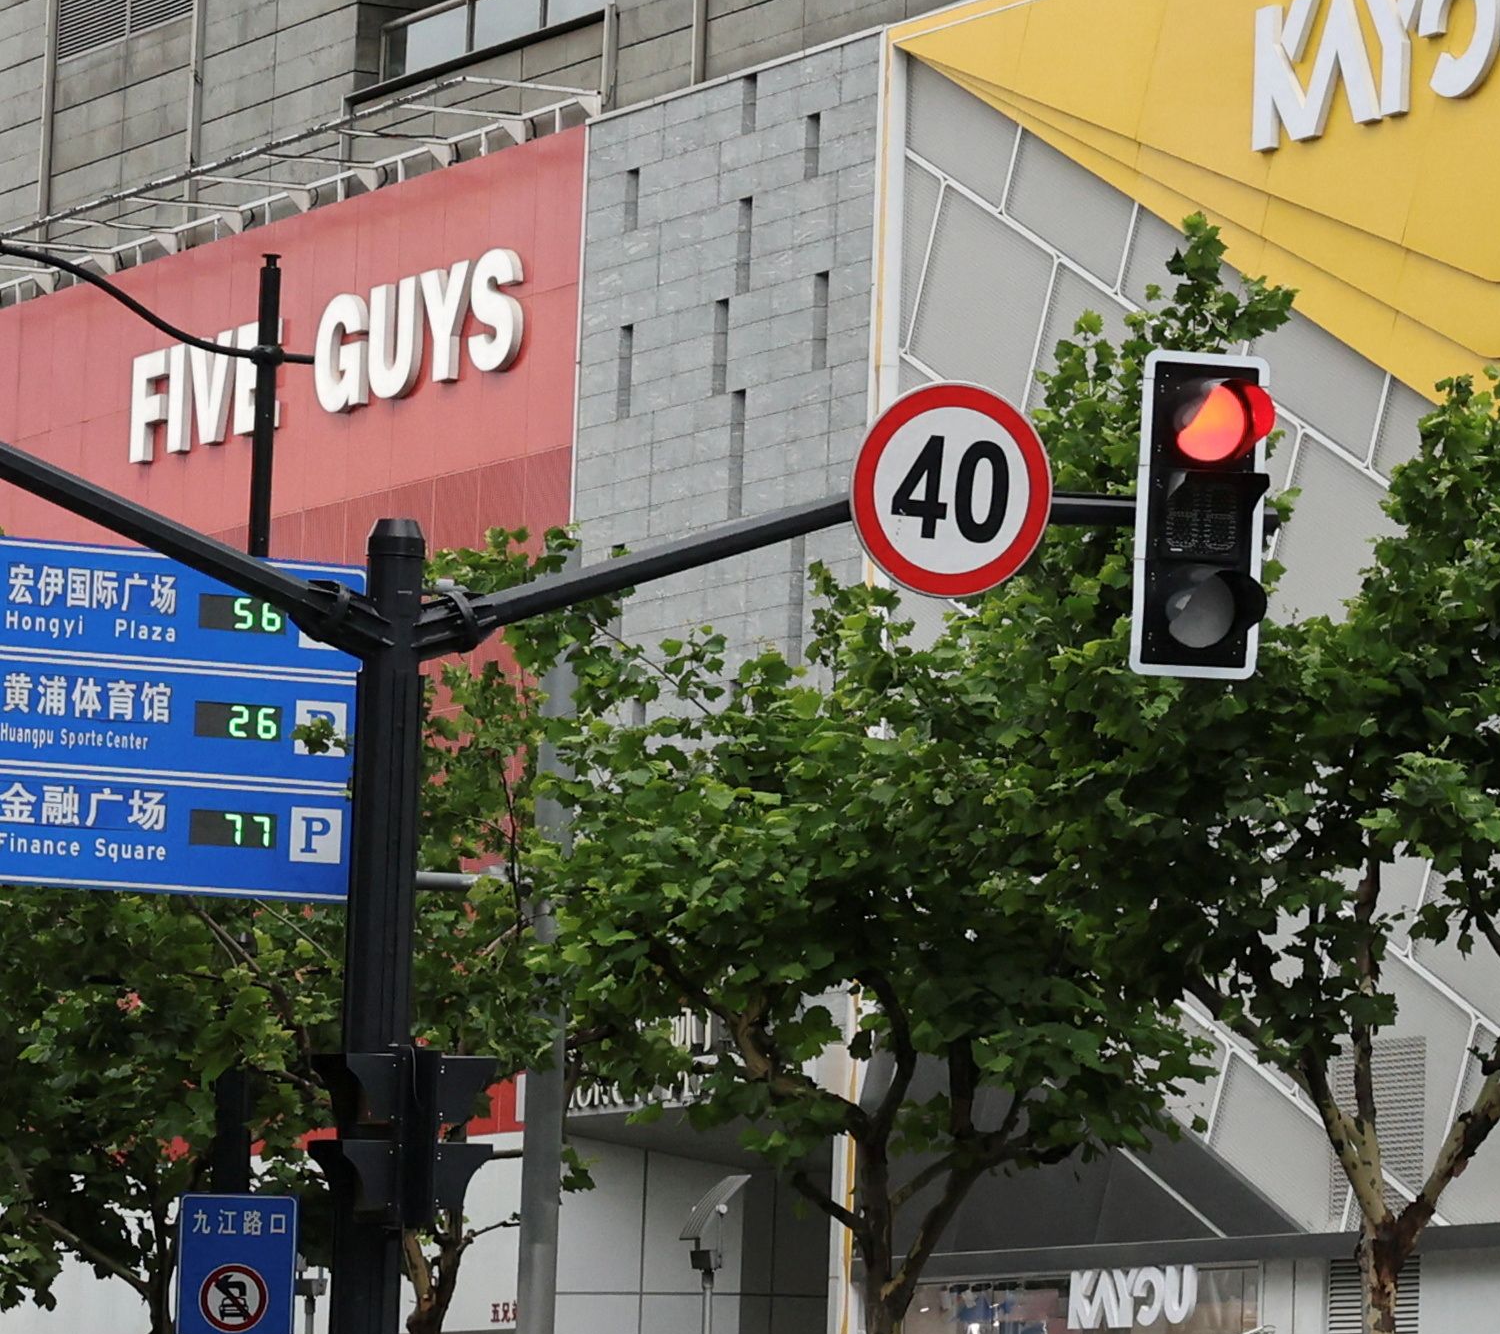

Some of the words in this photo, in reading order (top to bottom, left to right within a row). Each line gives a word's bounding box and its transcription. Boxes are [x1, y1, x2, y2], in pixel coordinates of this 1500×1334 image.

[313, 247, 525, 415] GUYS
[891, 434, 1010, 544] 40
[5, 610, 84, 638] Hongyi
[115, 618, 177, 643] Plaza
[8, 563, 178, 616] 宏伊国际广场
[232, 597, 282, 633] 56
[0, 723, 54, 750] Huangpu
[106, 730, 149, 750] Center
[3, 672, 172, 723] 黄浦体育馆
[228, 705, 278, 740] 26
[0, 781, 167, 832] 金融广场
[224, 813, 271, 848] 77
[300, 816, 332, 854] P
[0, 832, 81, 858] Finance
[95, 837, 167, 862] Square
[192, 1208, 287, 1236] 九江路口
[1067, 1264, 1198, 1330] KAYOU
